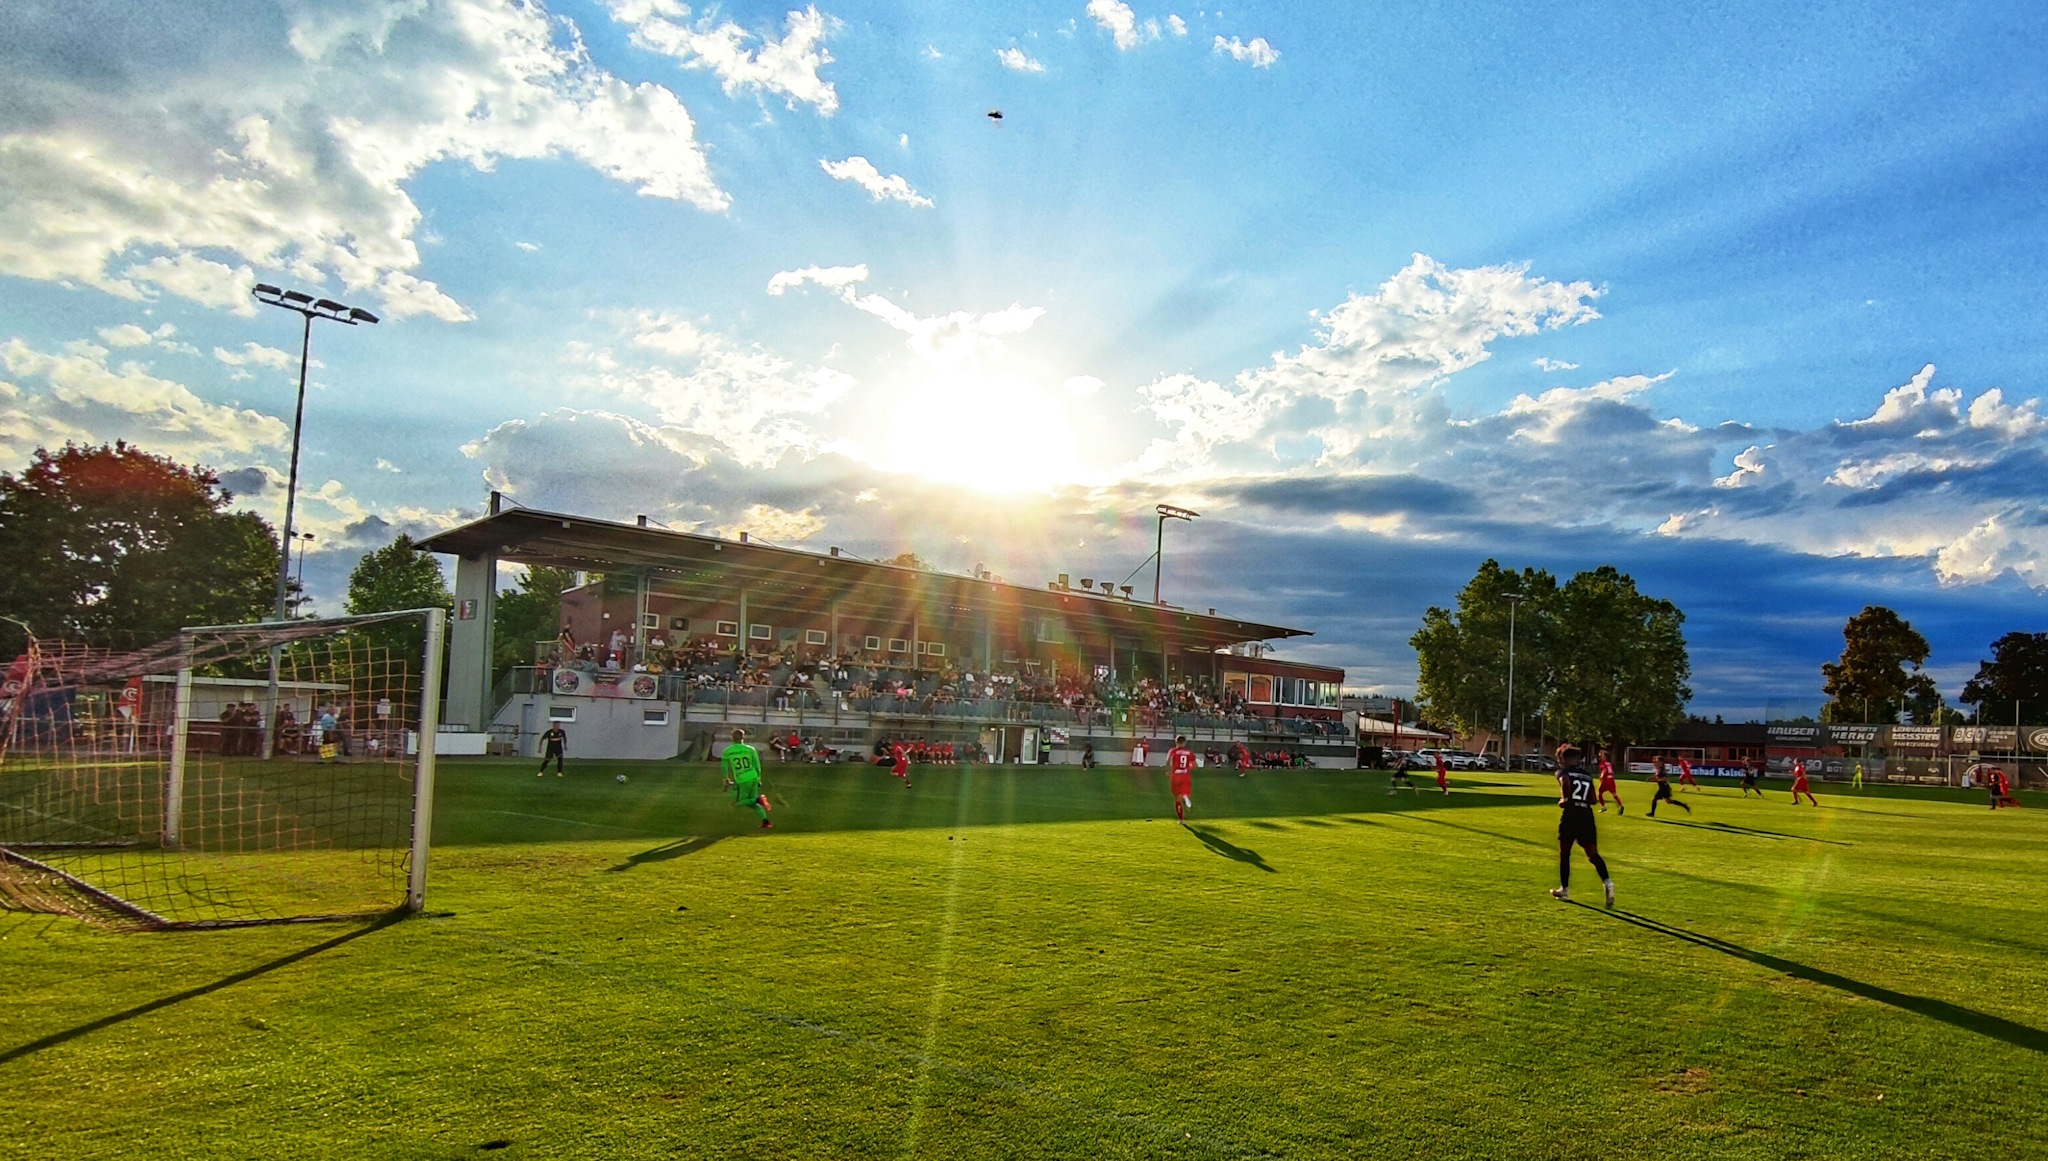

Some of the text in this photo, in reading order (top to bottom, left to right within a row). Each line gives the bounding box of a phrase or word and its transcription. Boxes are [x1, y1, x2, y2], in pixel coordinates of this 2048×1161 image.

[1767, 727, 1815, 735] HAUSER
[1831, 732, 1875, 740] HERKO
[733, 756, 750, 770] 30
[1180, 755, 1187, 768] 9
[1572, 780, 1590, 800] 27
